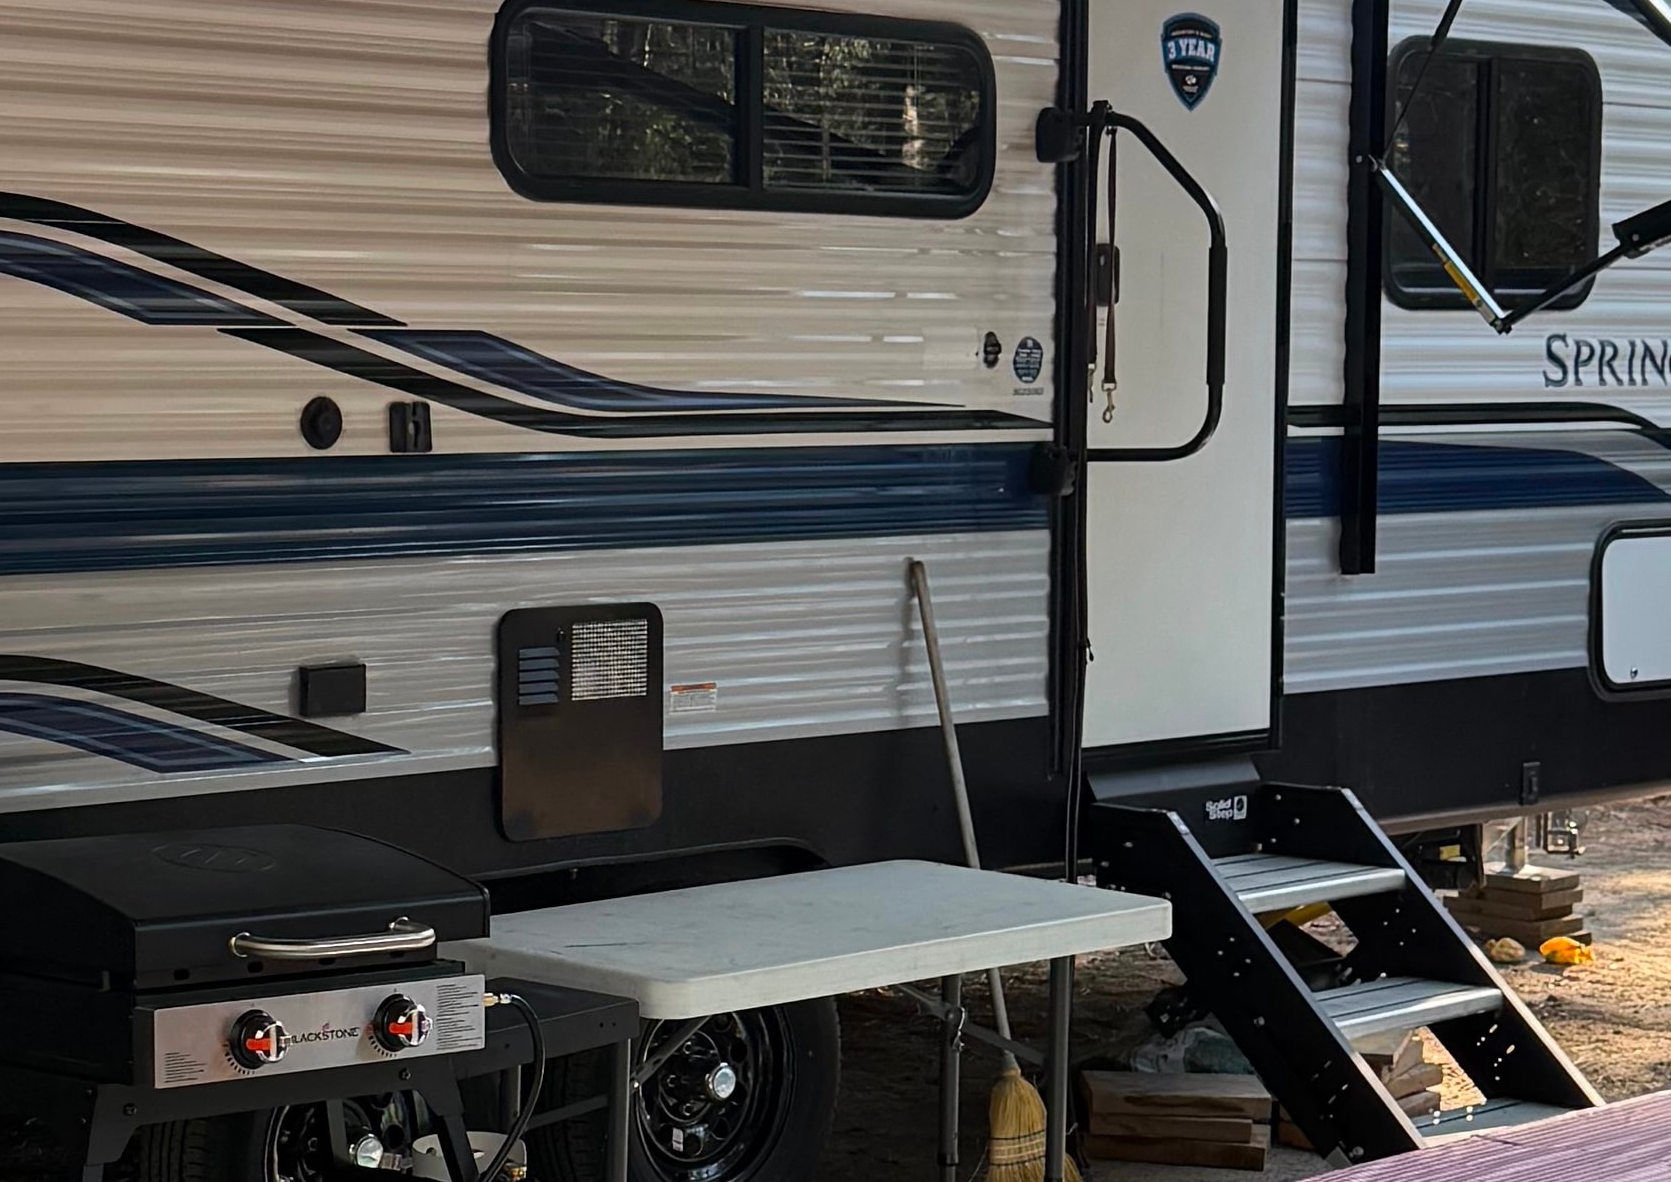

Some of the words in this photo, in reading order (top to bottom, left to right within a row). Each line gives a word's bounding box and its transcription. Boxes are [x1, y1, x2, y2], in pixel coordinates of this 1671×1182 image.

[1168, 40, 1176, 60] 3
[1179, 37, 1215, 62] YEAR
[1542, 333, 1671, 388] SPRIN
